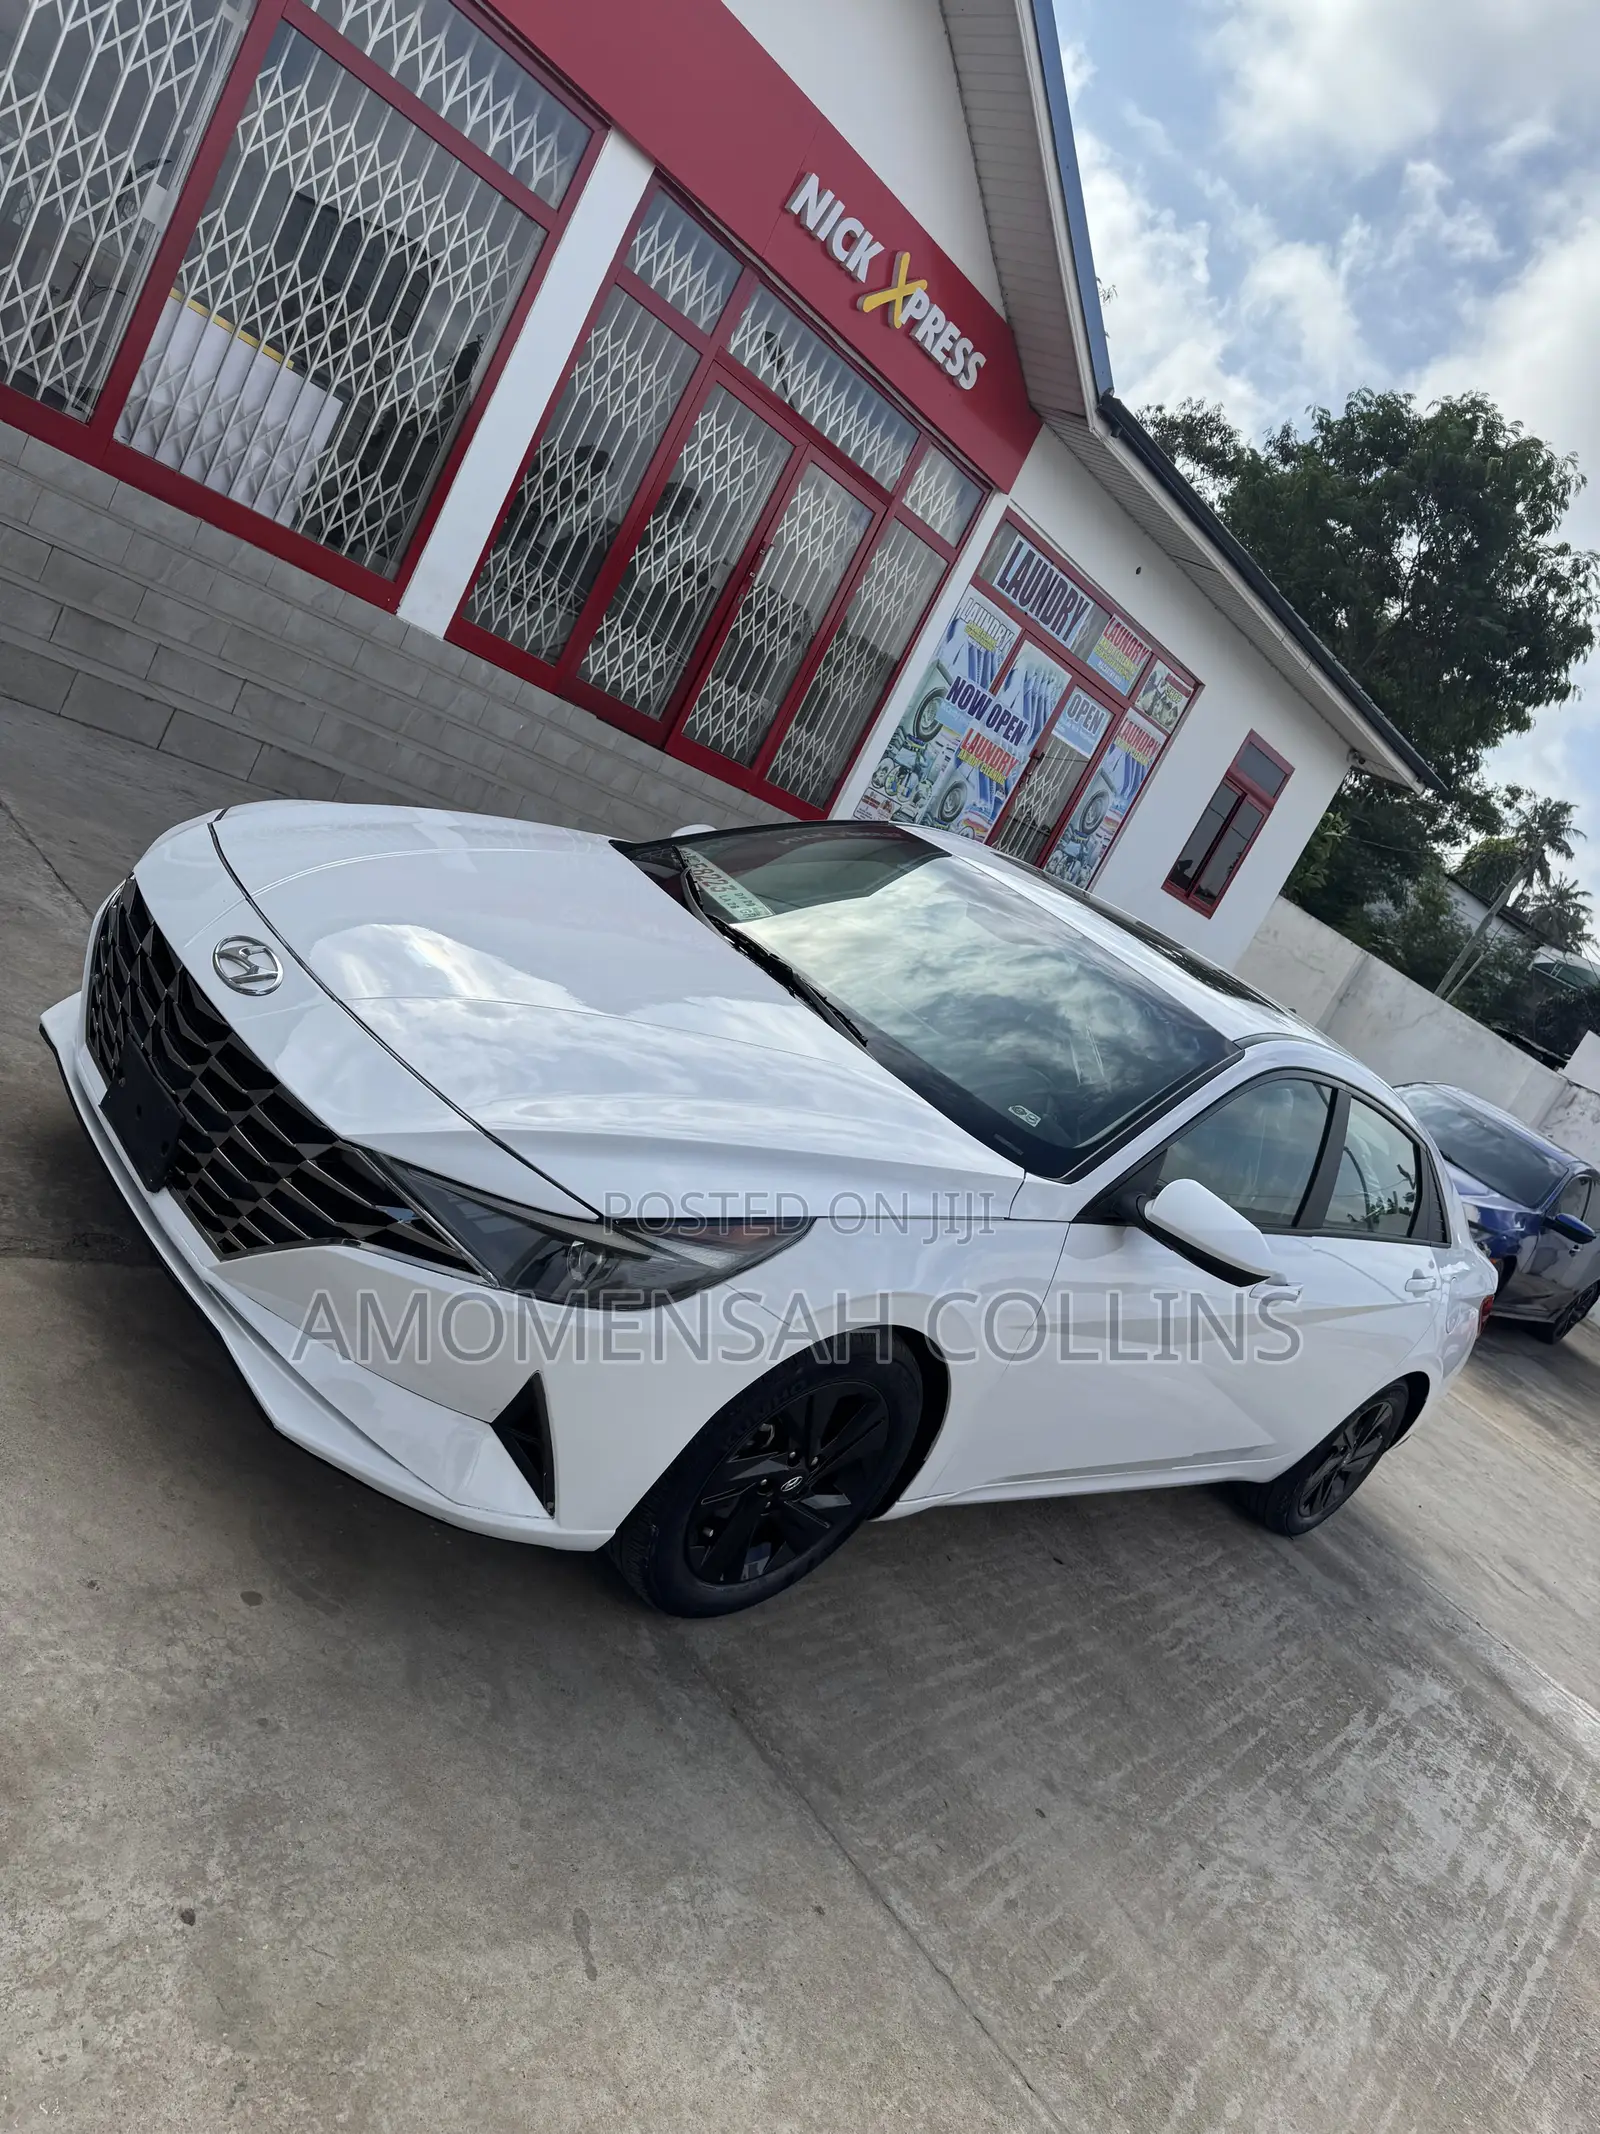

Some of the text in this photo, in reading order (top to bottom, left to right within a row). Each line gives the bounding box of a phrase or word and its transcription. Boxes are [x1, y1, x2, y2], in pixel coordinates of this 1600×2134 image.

[785, 172, 987, 390] NICK XPRESS
[996, 540, 1091, 642] LAUNDRY
[960, 597, 1015, 652] LAUNDRY
[1103, 617, 1150, 667] LAUNDRY
[946, 675, 993, 721] NOW
[985, 703, 1028, 747] OPEN
[1067, 693, 1105, 735] OPEN
[961, 727, 1020, 777] LAUNDRY
[1118, 718, 1162, 758] LAUNDRY
